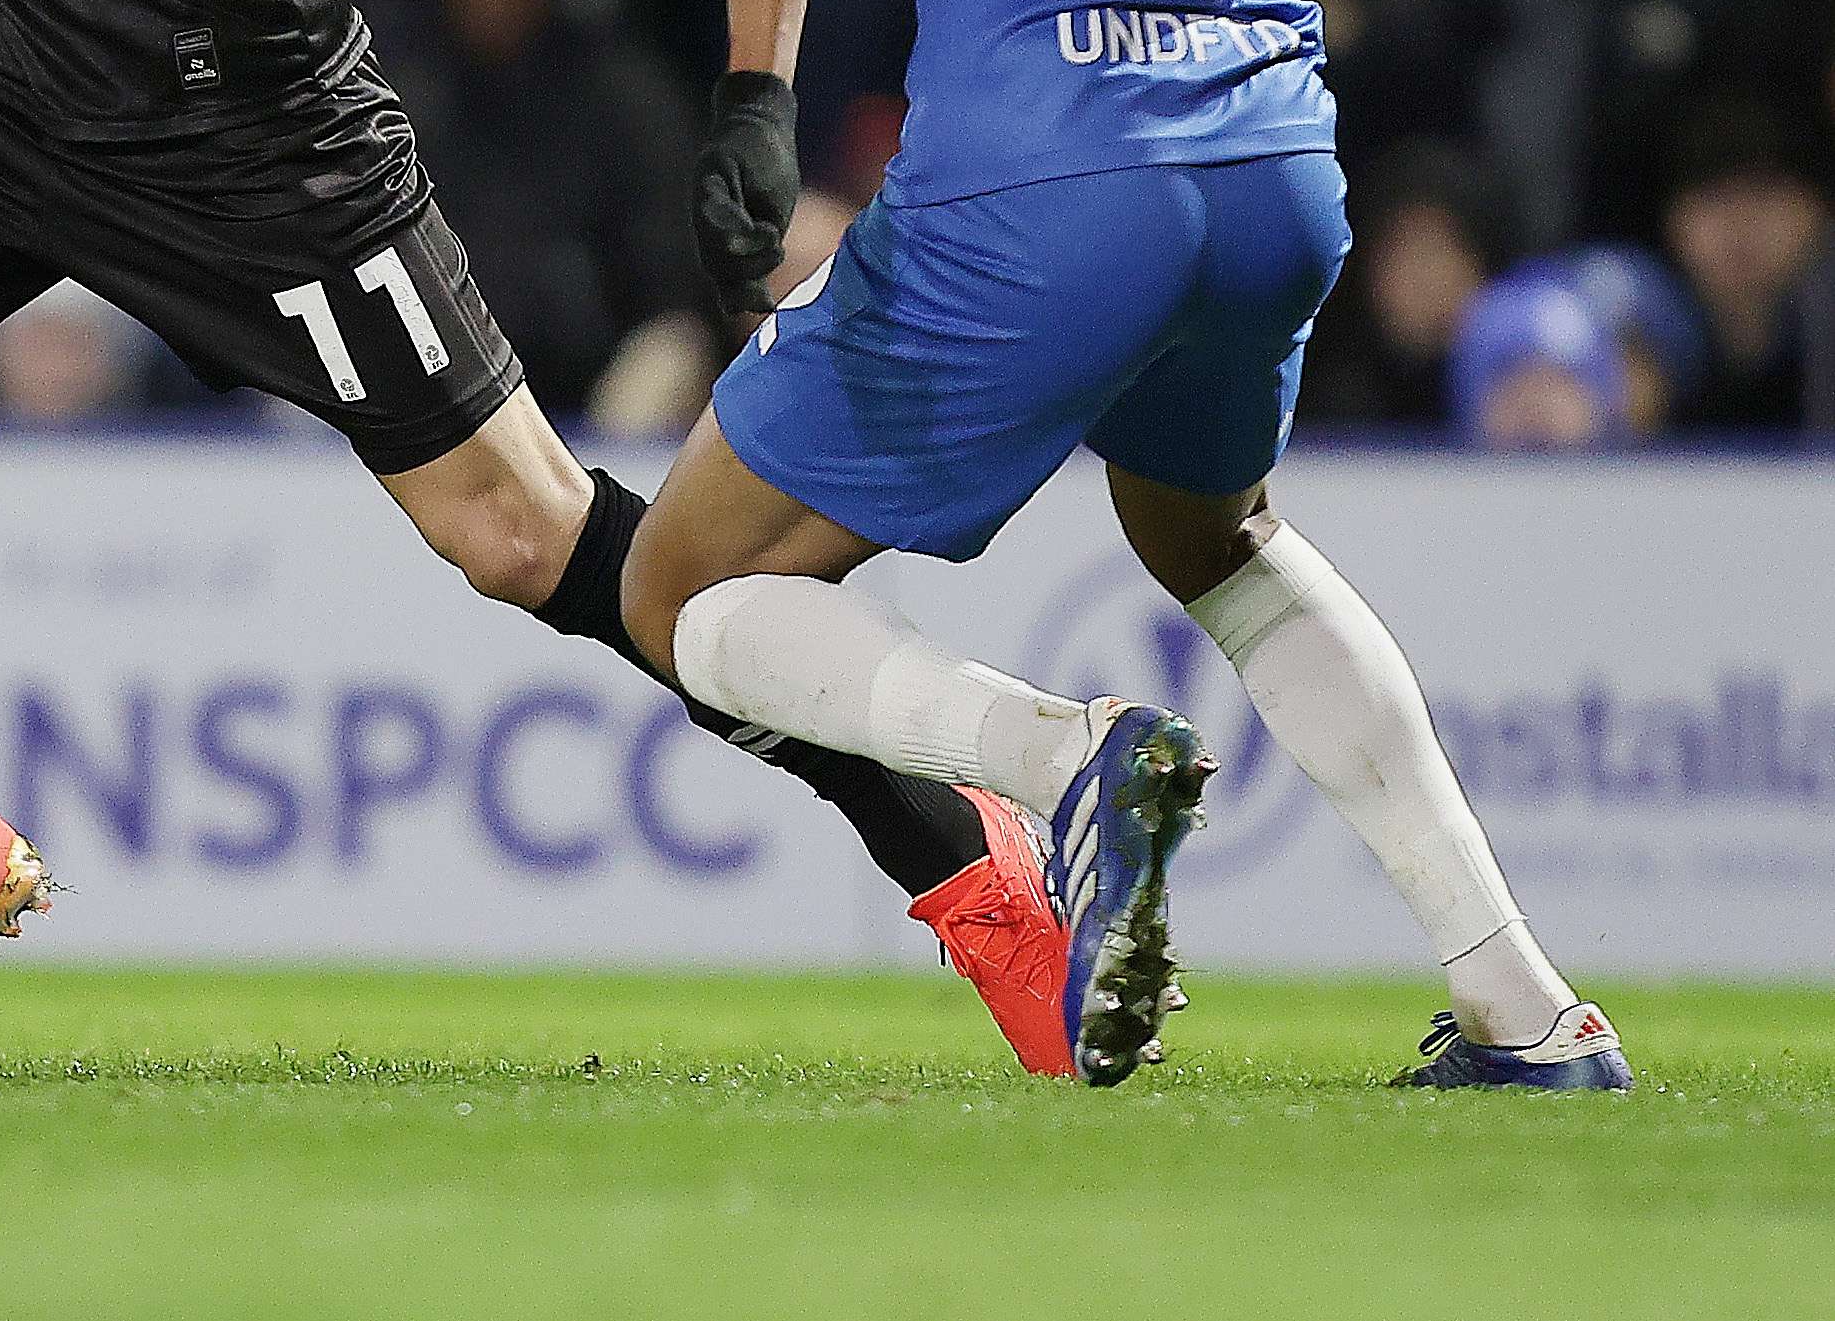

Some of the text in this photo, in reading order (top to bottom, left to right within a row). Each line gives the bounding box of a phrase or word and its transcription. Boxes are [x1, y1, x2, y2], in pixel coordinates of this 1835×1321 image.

[1055, 6, 1302, 65] UNDFTD
[271, 246, 453, 403] 11
[4, 672, 770, 875] NSPCC
